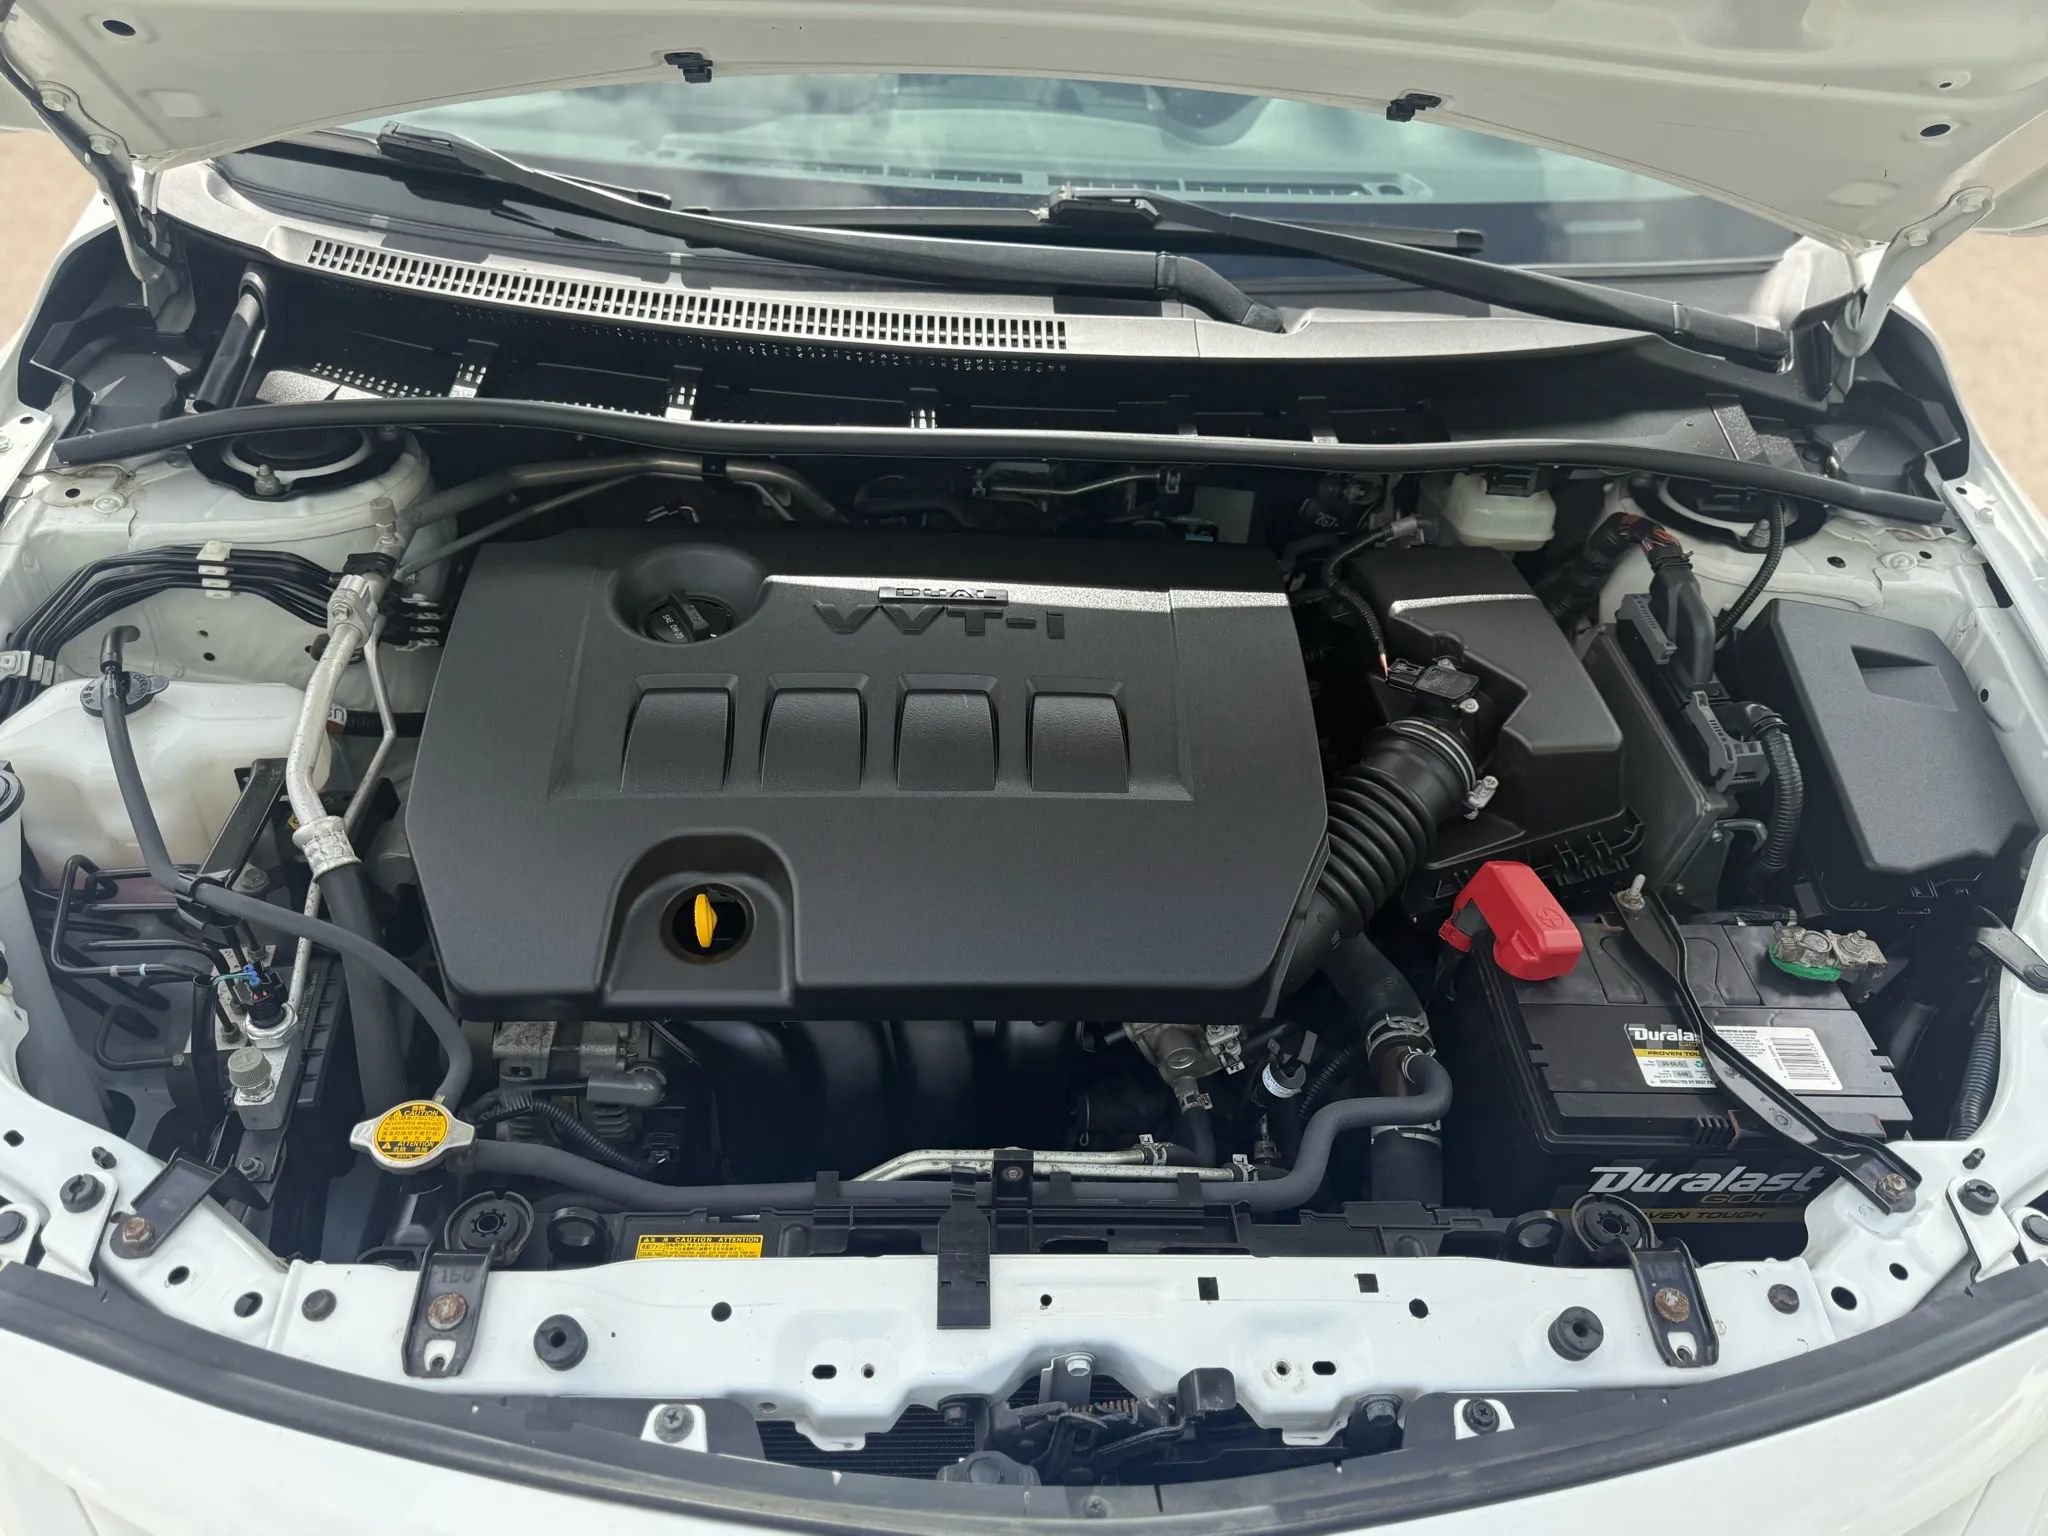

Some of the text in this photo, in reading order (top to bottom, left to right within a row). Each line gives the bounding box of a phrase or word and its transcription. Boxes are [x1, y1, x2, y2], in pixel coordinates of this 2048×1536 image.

[895, 587, 998, 599] DUAL
[1628, 1028, 1699, 1041] Durala
[1589, 1166, 1825, 1193] Duralast
[1700, 1193, 1805, 1204] GOLD
[1645, 1211, 1767, 1219] VEN TOUGH
